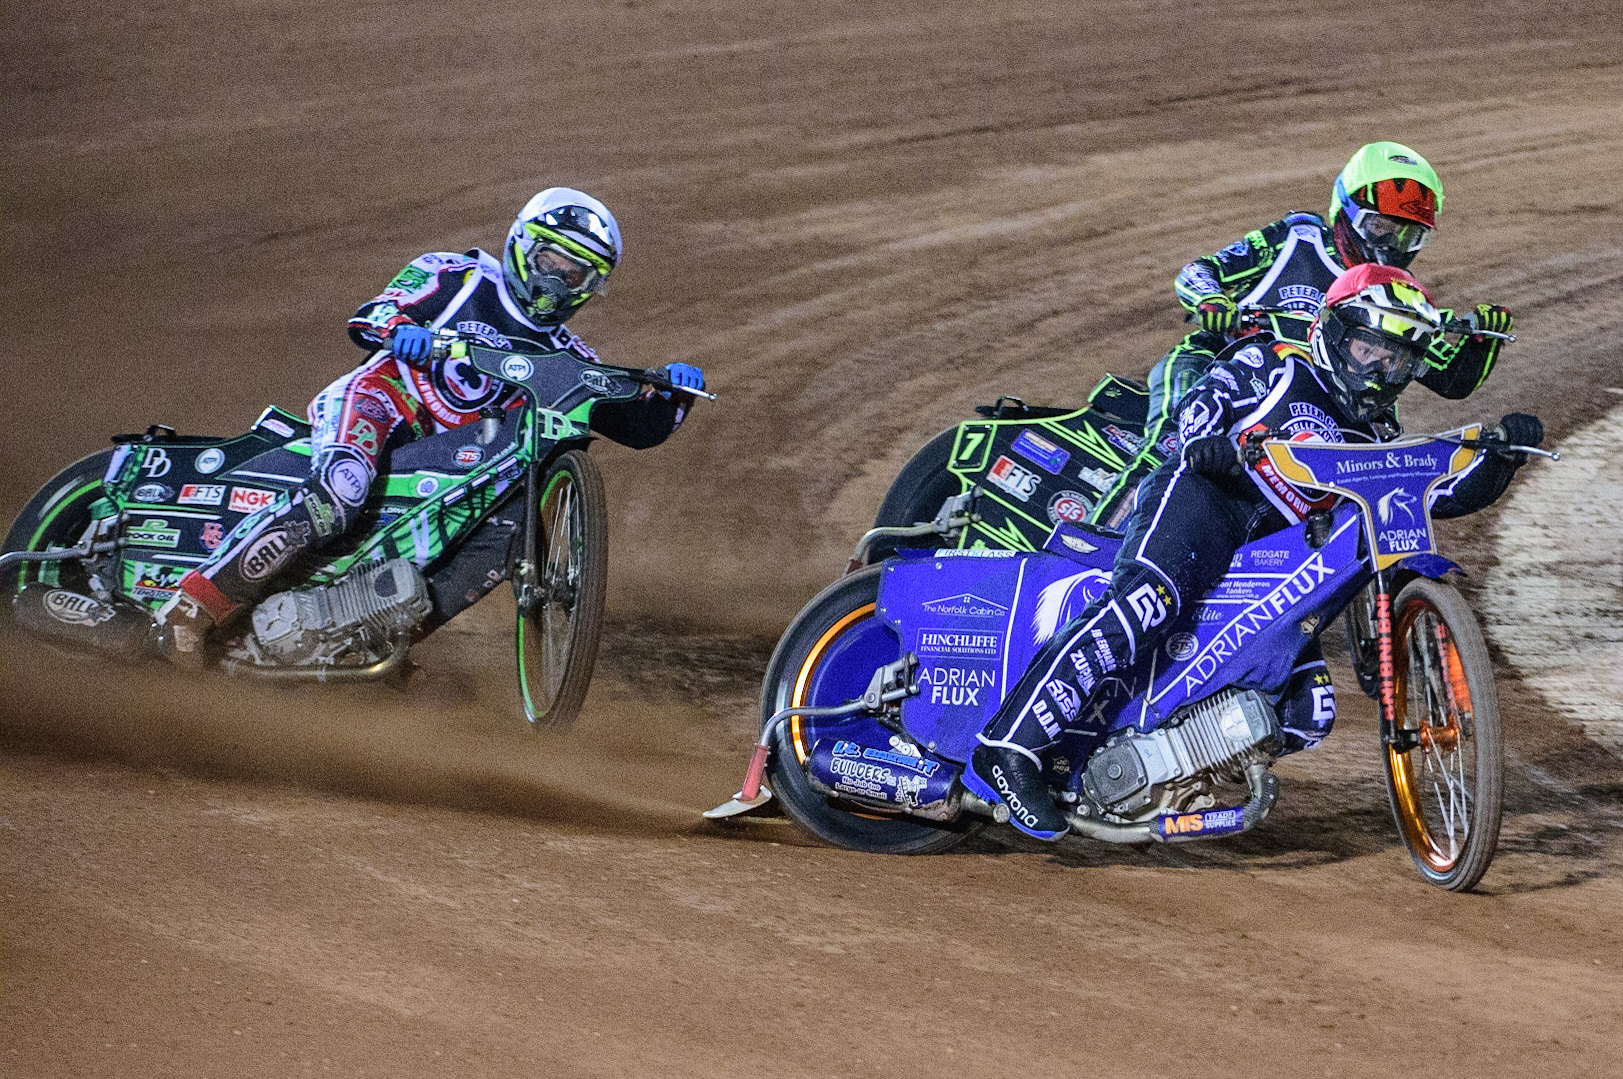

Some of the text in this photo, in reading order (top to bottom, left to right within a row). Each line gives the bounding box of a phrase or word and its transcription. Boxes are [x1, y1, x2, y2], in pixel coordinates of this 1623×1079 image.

[1290, 402, 1325, 422] PETER
[456, 452, 480, 463] STS
[1336, 451, 1438, 475] Minors & Brady
[338, 466, 362, 494] ATPI
[1005, 466, 1039, 494] FTS
[1261, 463, 1312, 515] MEMORIA
[232, 490, 273, 507] NGK
[1058, 501, 1082, 520] STS
[1378, 528, 1427, 542] ADRIAN
[1389, 538, 1420, 552] FLUX
[1250, 550, 1290, 559] REDGATE
[1254, 558, 1285, 567] BAKERY
[924, 604, 1006, 617] The Norfolk Cabin Co
[921, 633, 998, 648] HINCHLIFFE
[917, 667, 996, 688] ADRIAN
[1070, 648, 1098, 691] ZUPIN
[931, 686, 980, 707] FLUX
[830, 758, 891, 784] BUILDERS
[842, 776, 853, 785] No
[854, 779, 867, 788] Job
[867, 781, 881, 791] too
[866, 789, 888, 800] Small
[991, 764, 1039, 829] daytona
[1205, 820, 1236, 829] SUPPLIES
